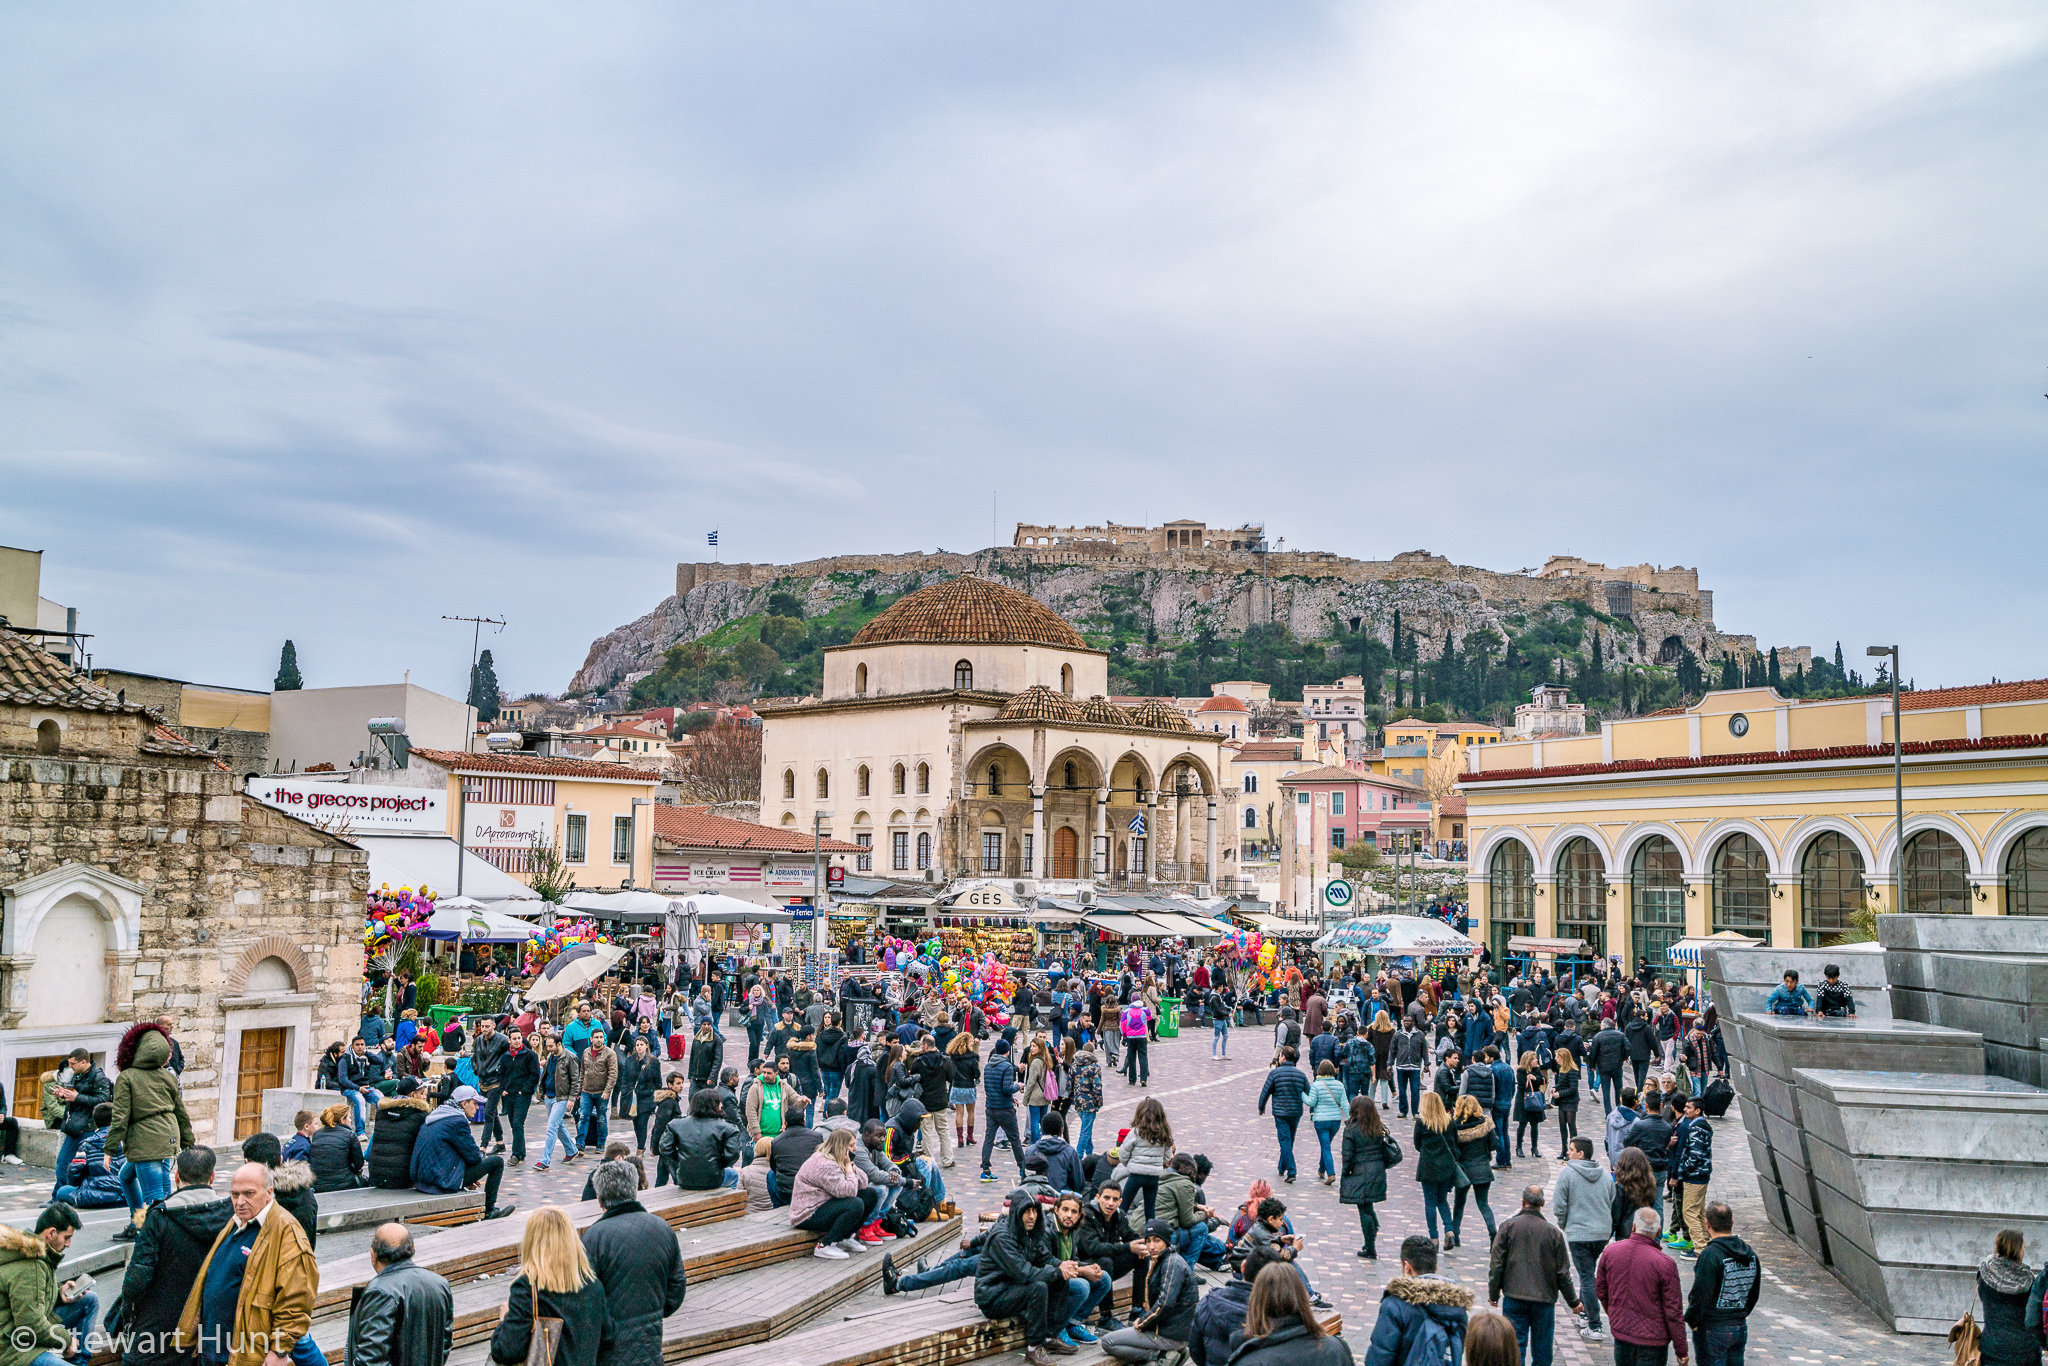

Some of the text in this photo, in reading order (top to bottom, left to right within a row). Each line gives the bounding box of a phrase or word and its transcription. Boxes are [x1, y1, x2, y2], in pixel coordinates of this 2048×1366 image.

[275, 788, 428, 812] the greco's project
[321, 813, 375, 821] TRDTIONAL
[970, 893, 1002, 905] GES
[796, 908, 813, 916] Ferries
